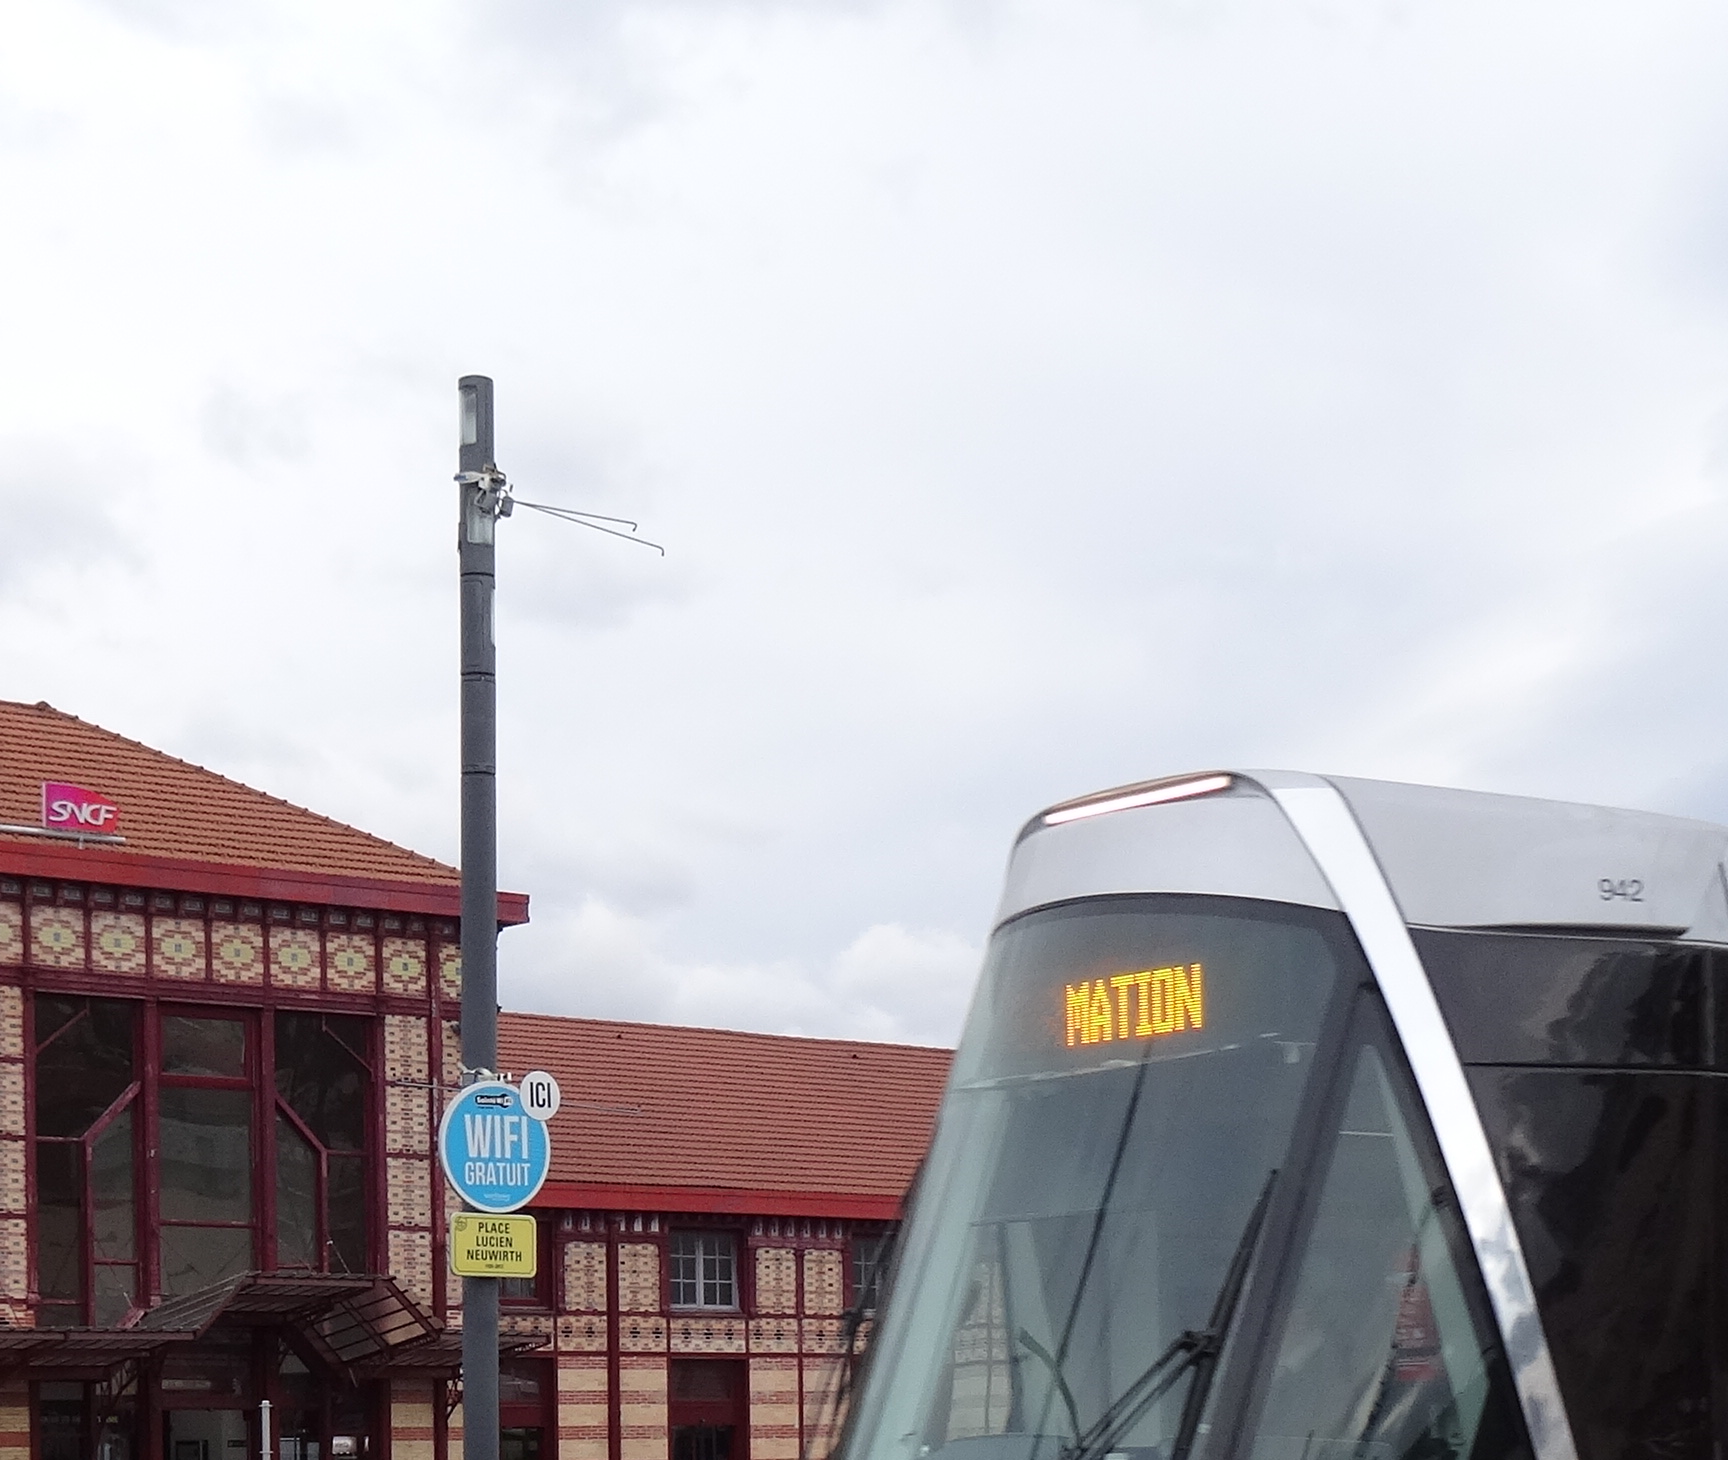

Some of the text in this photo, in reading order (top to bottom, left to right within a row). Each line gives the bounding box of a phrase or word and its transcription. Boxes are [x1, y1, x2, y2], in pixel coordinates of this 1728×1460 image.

[47, 799, 118, 827] SNCF
[1597, 878, 1645, 903] 942
[1065, 963, 1203, 1047] MATION
[529, 1081, 552, 1109] ICI
[464, 1113, 529, 1160] WIFI
[464, 1161, 531, 1187] GRATUIT
[477, 1221, 511, 1235] PLACE
[475, 1235, 513, 1249] LUCIEN
[466, 1248, 523, 1263] NEUWIRTH
